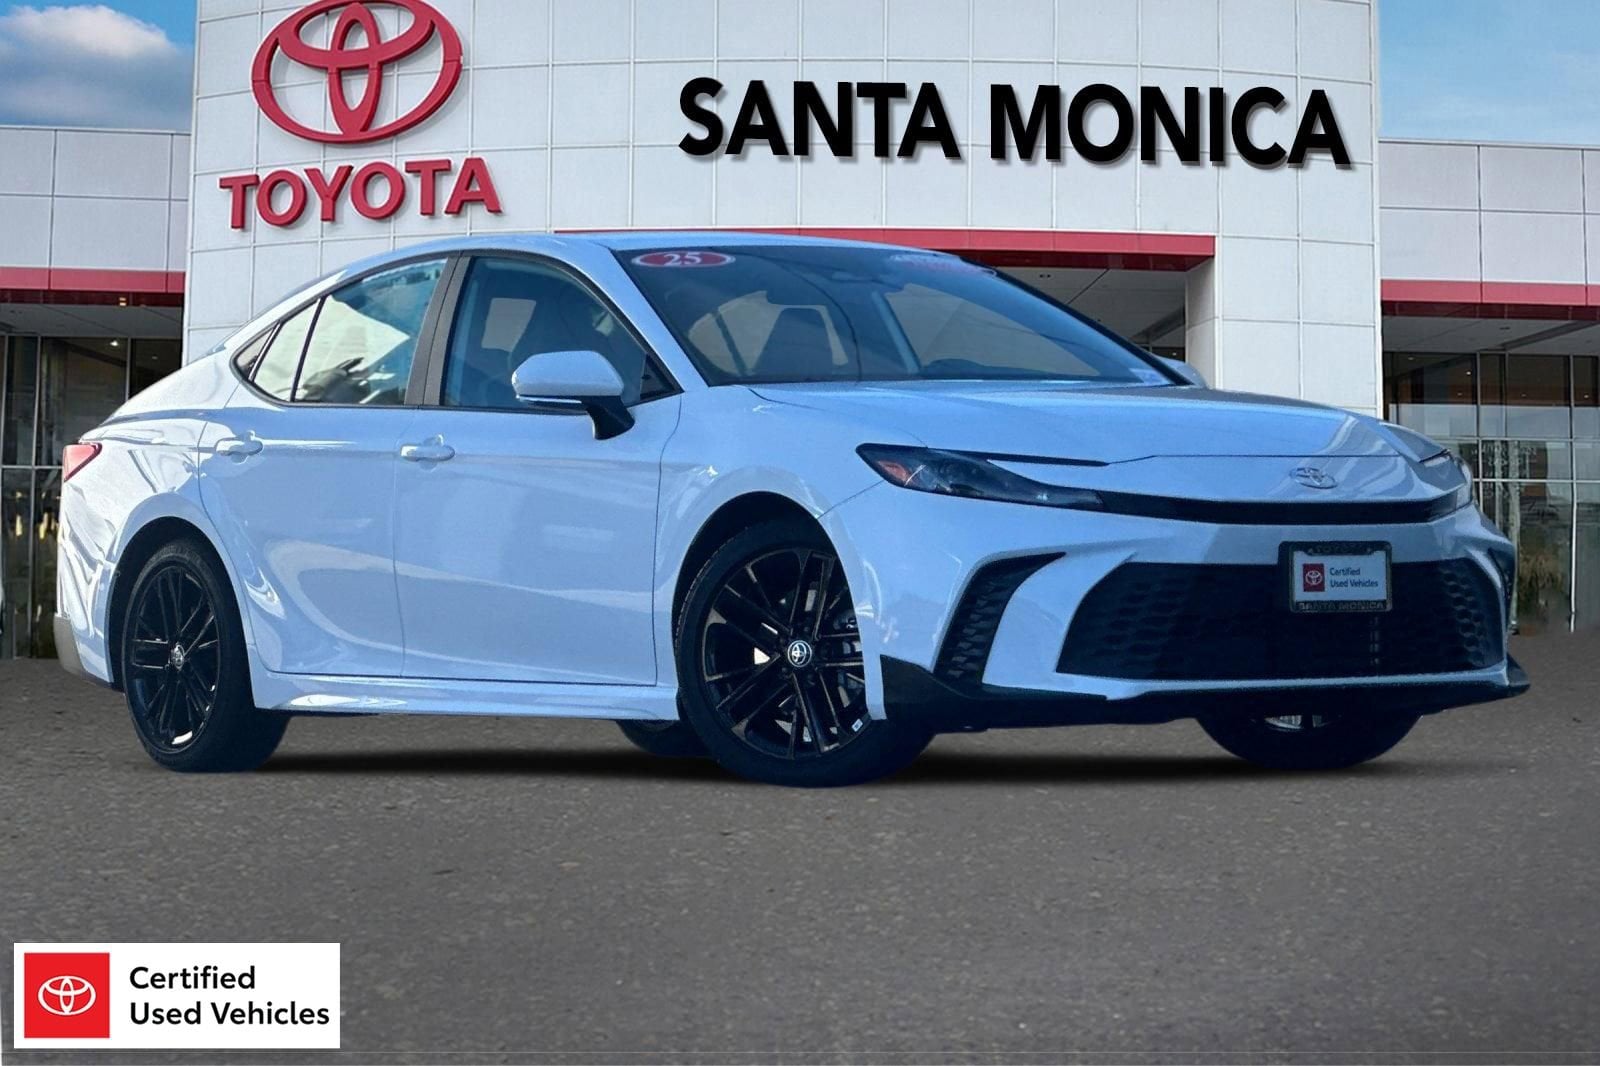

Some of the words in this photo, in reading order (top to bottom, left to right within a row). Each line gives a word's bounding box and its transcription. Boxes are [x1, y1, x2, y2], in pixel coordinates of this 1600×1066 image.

[678, 77, 961, 158] SANTA
[990, 83, 1351, 167] MONICA
[219, 157, 502, 229] TOYOTA
[663, 251, 702, 266] 25
[1329, 567, 1361, 576] Certified
[1330, 579, 1349, 588] Used
[1350, 579, 1379, 588] Vehicles
